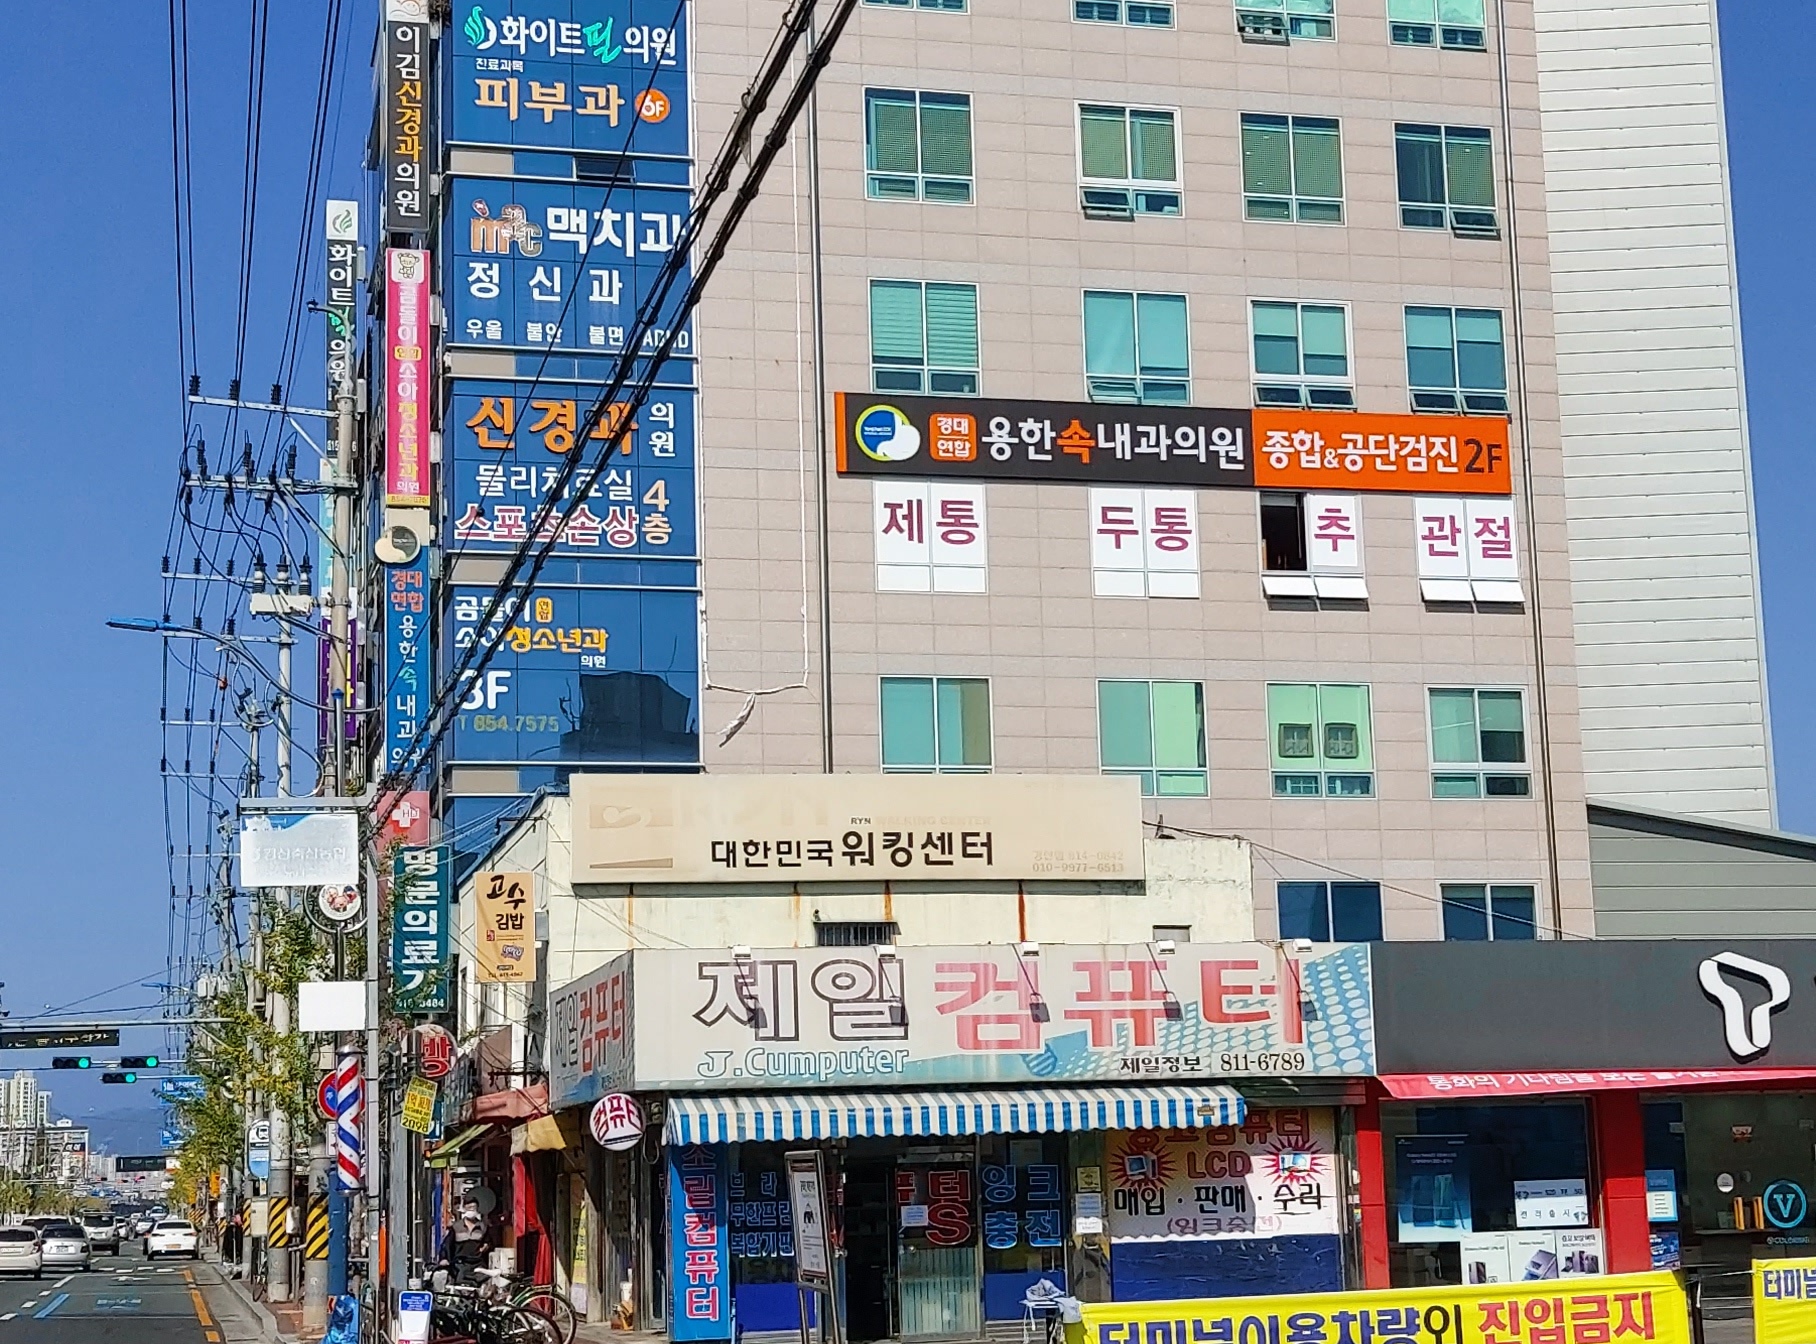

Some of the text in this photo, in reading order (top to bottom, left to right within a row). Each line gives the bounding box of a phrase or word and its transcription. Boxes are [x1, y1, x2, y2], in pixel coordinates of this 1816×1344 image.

[475, 58, 525, 73] 진료과목
[474, 77, 626, 128] 피부과
[643, 94, 666, 117] 6F
[546, 206, 687, 258] 맥치과
[466, 319, 503, 341] 우울
[526, 322, 564, 343] 불안
[588, 325, 625, 346] 불면
[466, 395, 639, 456] 신경과
[648, 402, 676, 458] 의원
[937, 417, 969, 435] 경대
[937, 439, 971, 458] 연합
[981, 416, 1503, 474] 용한속내과의원 종합&공단검진 2F
[1095, 504, 1194, 554] 두통
[1313, 506, 1355, 553] 추
[1420, 514, 1513, 561] 관절
[580, 655, 606, 668] 의원
[456, 668, 512, 710] 3F
[850, 816, 872, 826] RYN
[486, 874, 527, 911] 고수
[495, 912, 525, 931] 김밥
[698, 1046, 910, 1083] J.Cumputer
[1120, 1052, 1306, 1074] 제일정보 811-6789
[1427, 1073, 1501, 1091] 통화의
[1186, 1150, 1253, 1179] LCD
[982, 1164, 1061, 1203] 잉크
[1113, 1187, 1166, 1216] 매입
[1194, 1185, 1246, 1214] 판매
[1273, 1183, 1322, 1211] 수리
[983, 1208, 1063, 1250] 충전
